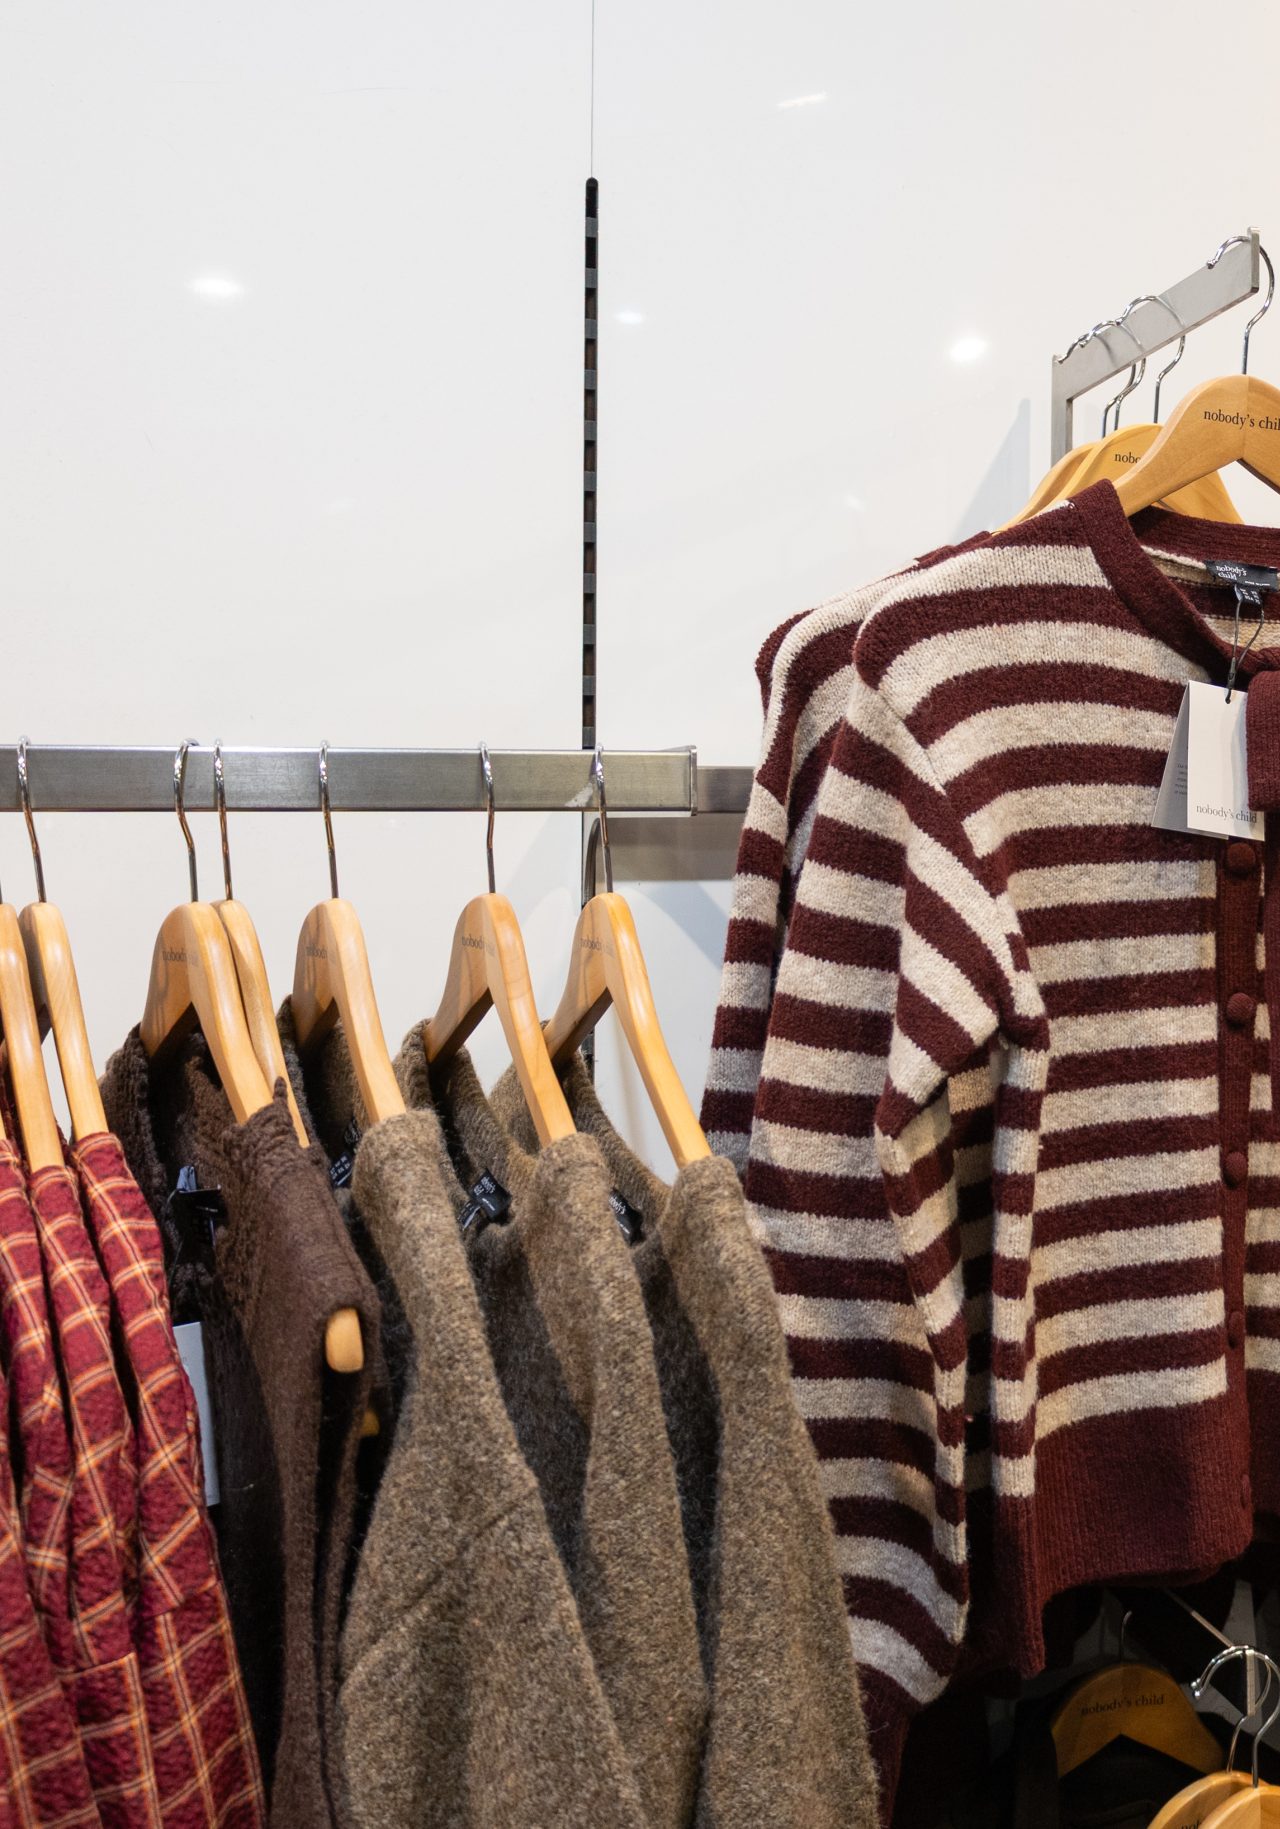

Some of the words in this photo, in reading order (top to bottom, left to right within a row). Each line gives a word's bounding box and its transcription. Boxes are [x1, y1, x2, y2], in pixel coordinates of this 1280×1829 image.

[1204, 409, 1254, 429] nobody's
[1216, 565, 1247, 577] nobody's
[1196, 804, 1234, 820] nobody's
[1235, 811, 1257, 823] child
[1080, 1697, 1132, 1715] nobody's
[1135, 1694, 1164, 1706] child
